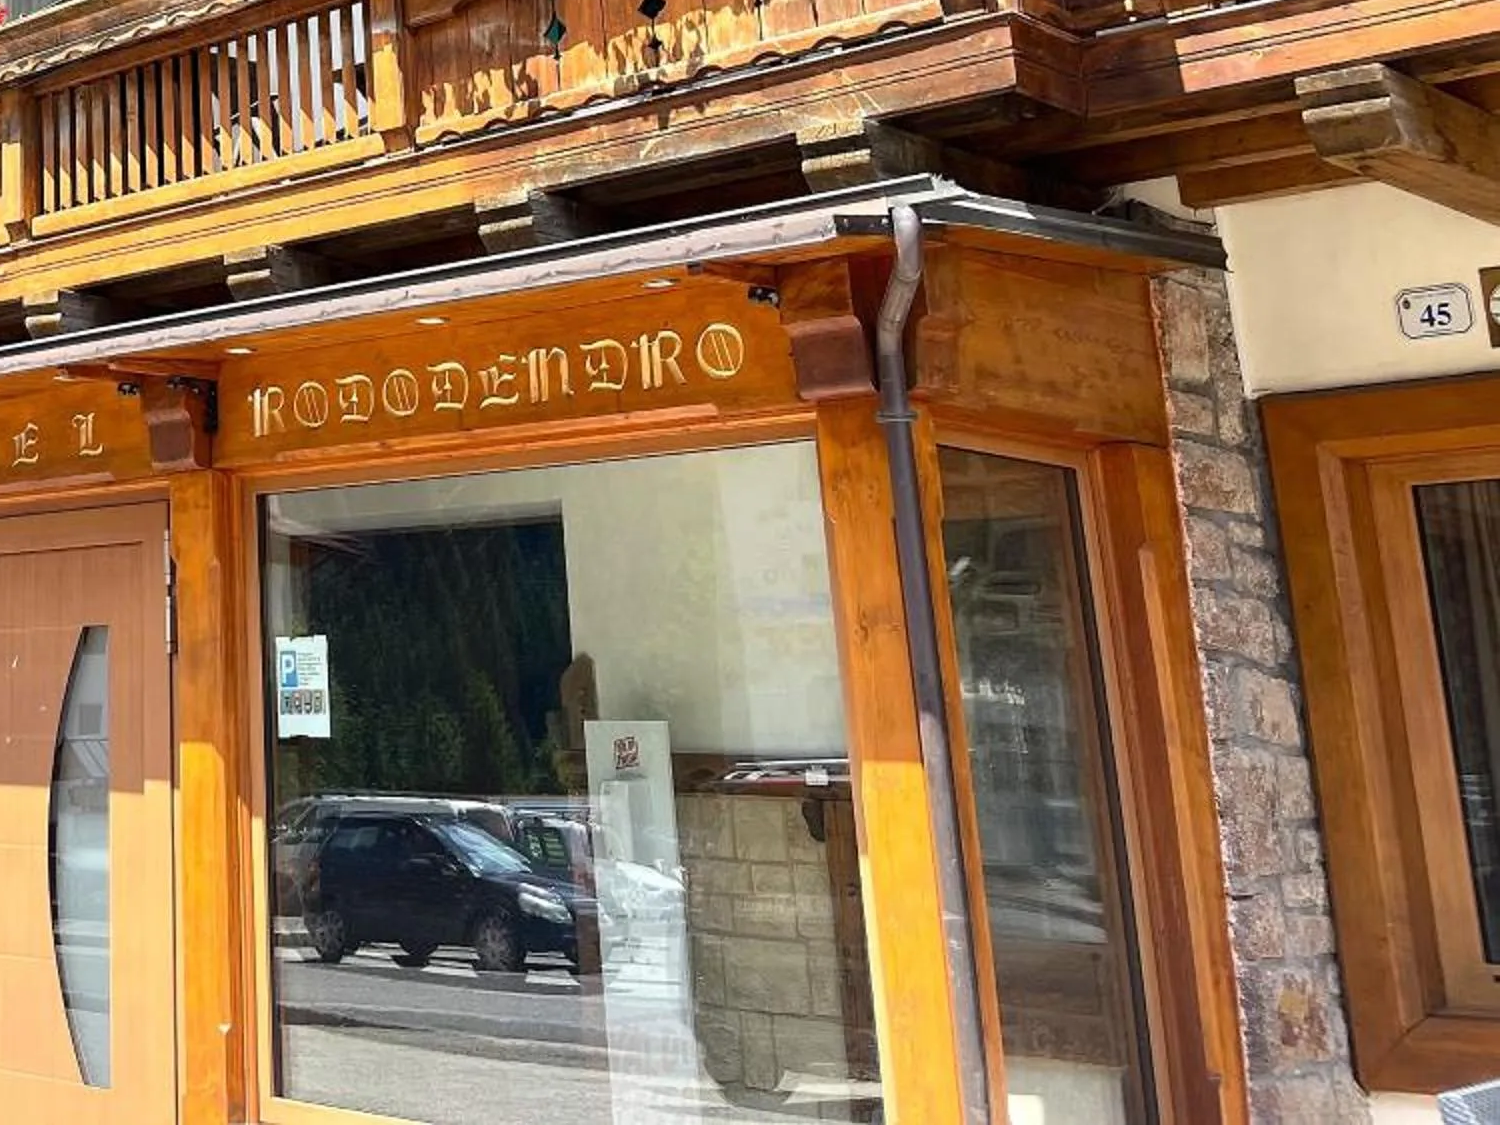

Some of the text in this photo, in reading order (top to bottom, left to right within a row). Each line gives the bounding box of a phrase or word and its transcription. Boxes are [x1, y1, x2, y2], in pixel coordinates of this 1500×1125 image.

[1419, 302, 1452, 328] 45
[247, 322, 745, 438] RODODENDRO
[281, 654, 295, 684] P
